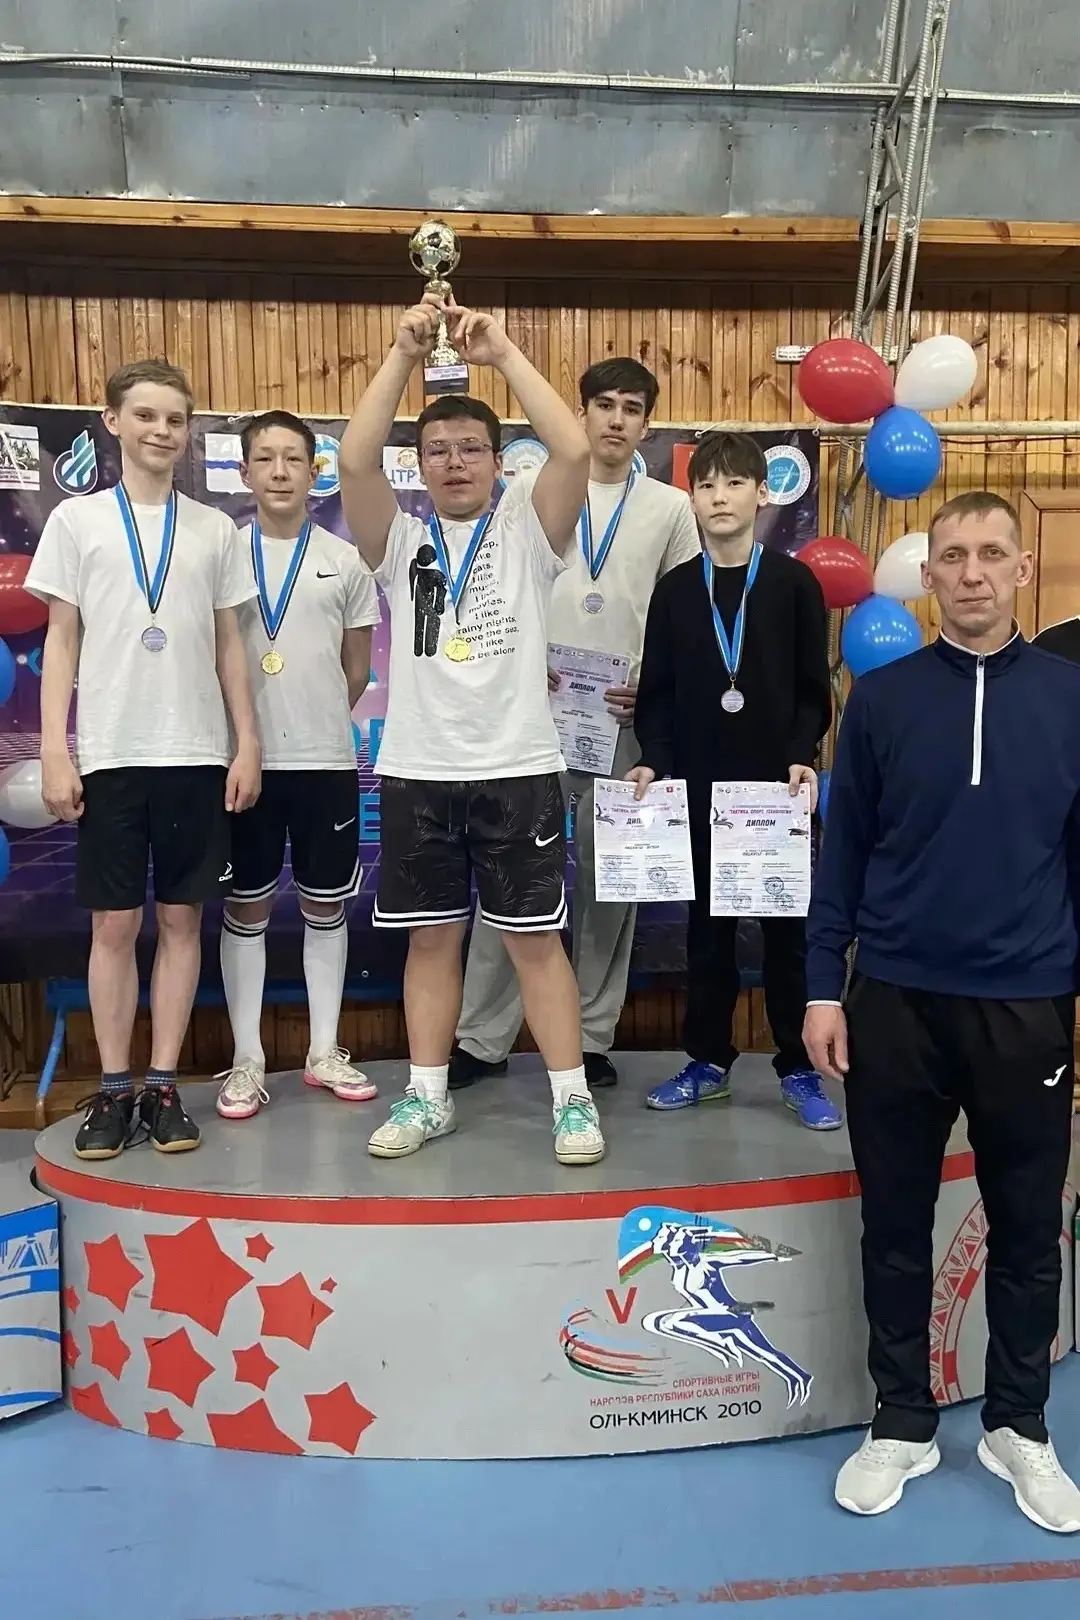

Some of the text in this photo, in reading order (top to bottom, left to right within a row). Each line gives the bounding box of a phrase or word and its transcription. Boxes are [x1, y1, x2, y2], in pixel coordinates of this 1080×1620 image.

[481, 609, 500, 619] like
[457, 623, 483, 635] rainy
[465, 634, 484, 643] ove
[486, 628, 502, 637] the
[486, 638, 504, 648] like
[493, 646, 516, 656] alone
[568, 681, 597, 692] ДИПЛОМ
[745, 819, 776, 827] ДИПЛОМ
[605, 1286, 638, 1325] V
[672, 1371, 760, 1389] СПОРТИВНЫЕ ИГРЫ
[636, 1389, 694, 1403] РЕСПУБЛИКИ
[696, 1387, 720, 1398] САХА
[721, 1384, 761, 1396] (ЯКУТИЯ)
[717, 1399, 762, 1419] 2010
